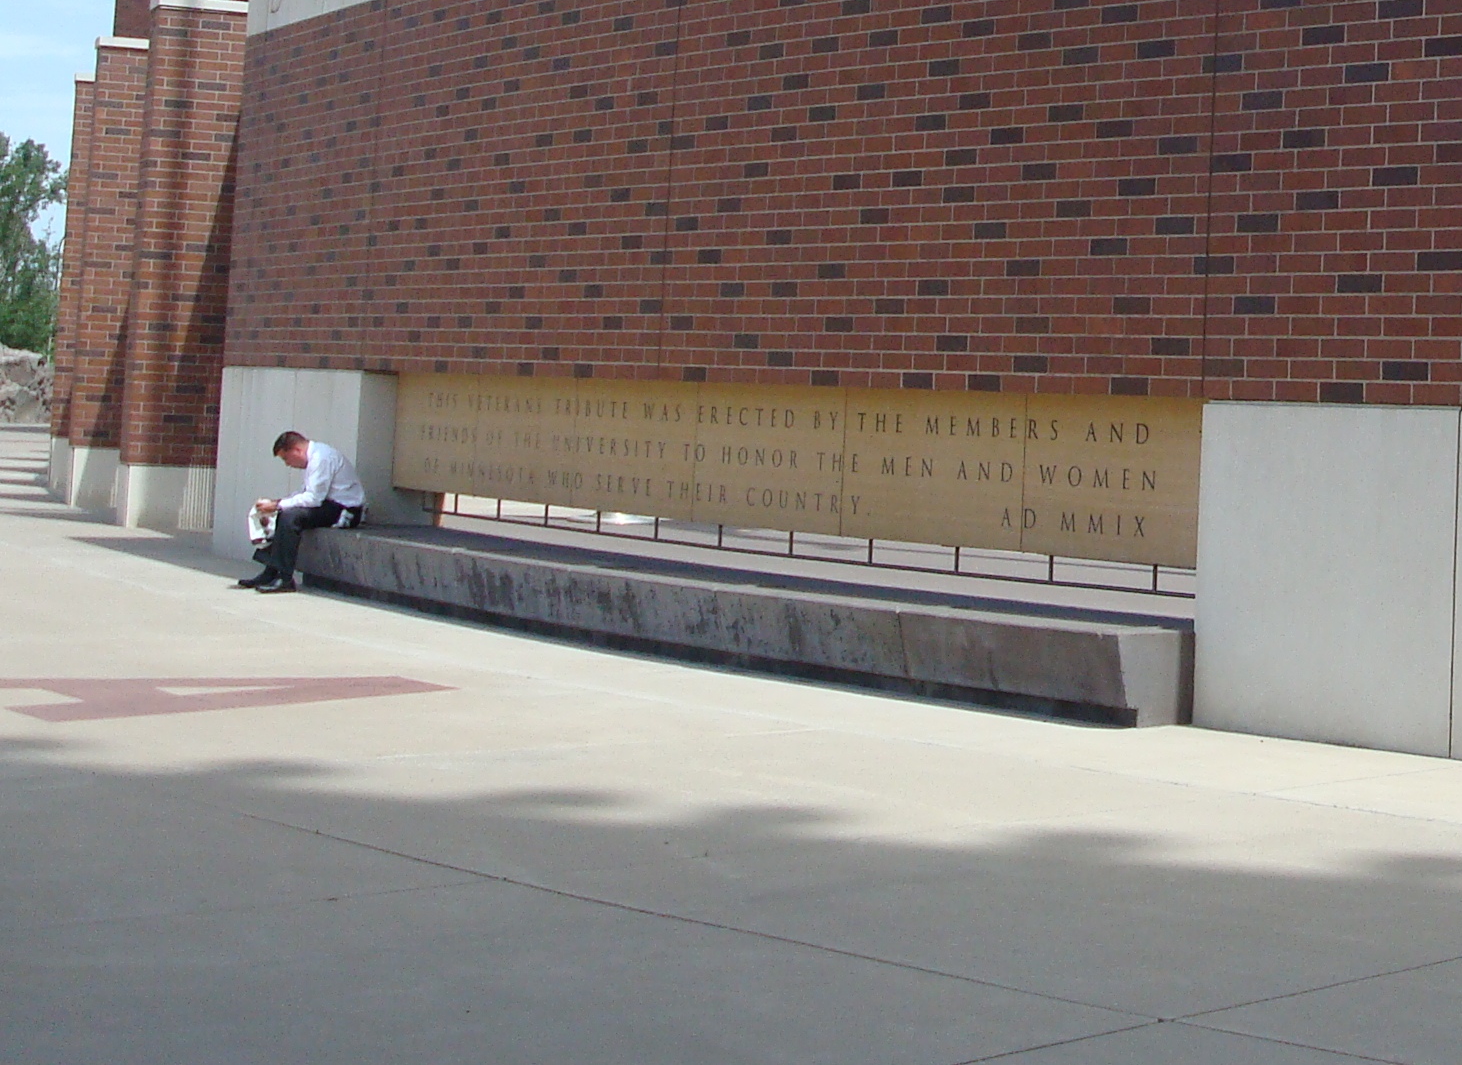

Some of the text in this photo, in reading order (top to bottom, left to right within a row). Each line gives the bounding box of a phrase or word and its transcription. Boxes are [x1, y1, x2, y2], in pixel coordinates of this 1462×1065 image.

[428, 391, 458, 410] THIS
[555, 398, 629, 420] TRIBUTE
[643, 401, 682, 423] WAS
[697, 405, 796, 429] ERECTED
[812, 410, 839, 431] BY
[857, 412, 903, 434] THE
[924, 415, 1059, 441] MEMBERS
[1084, 421, 1150, 446] AND
[514, 431, 541, 451] THE
[552, 433, 667, 460] UNIVERSITY
[683, 443, 706, 463] TO
[721, 445, 798, 469] HONOR
[816, 451, 859, 473] THE
[880, 455, 934, 478] MEN
[956, 459, 1014, 484] AND
[1039, 463, 1157, 492] WOMEN
[547, 468, 584, 490] WHO
[595, 473, 652, 497] SERVE
[666, 479, 728, 504] THEIR
[1000, 507, 1037, 530] AD
[1060, 511, 1146, 538] MMIX
